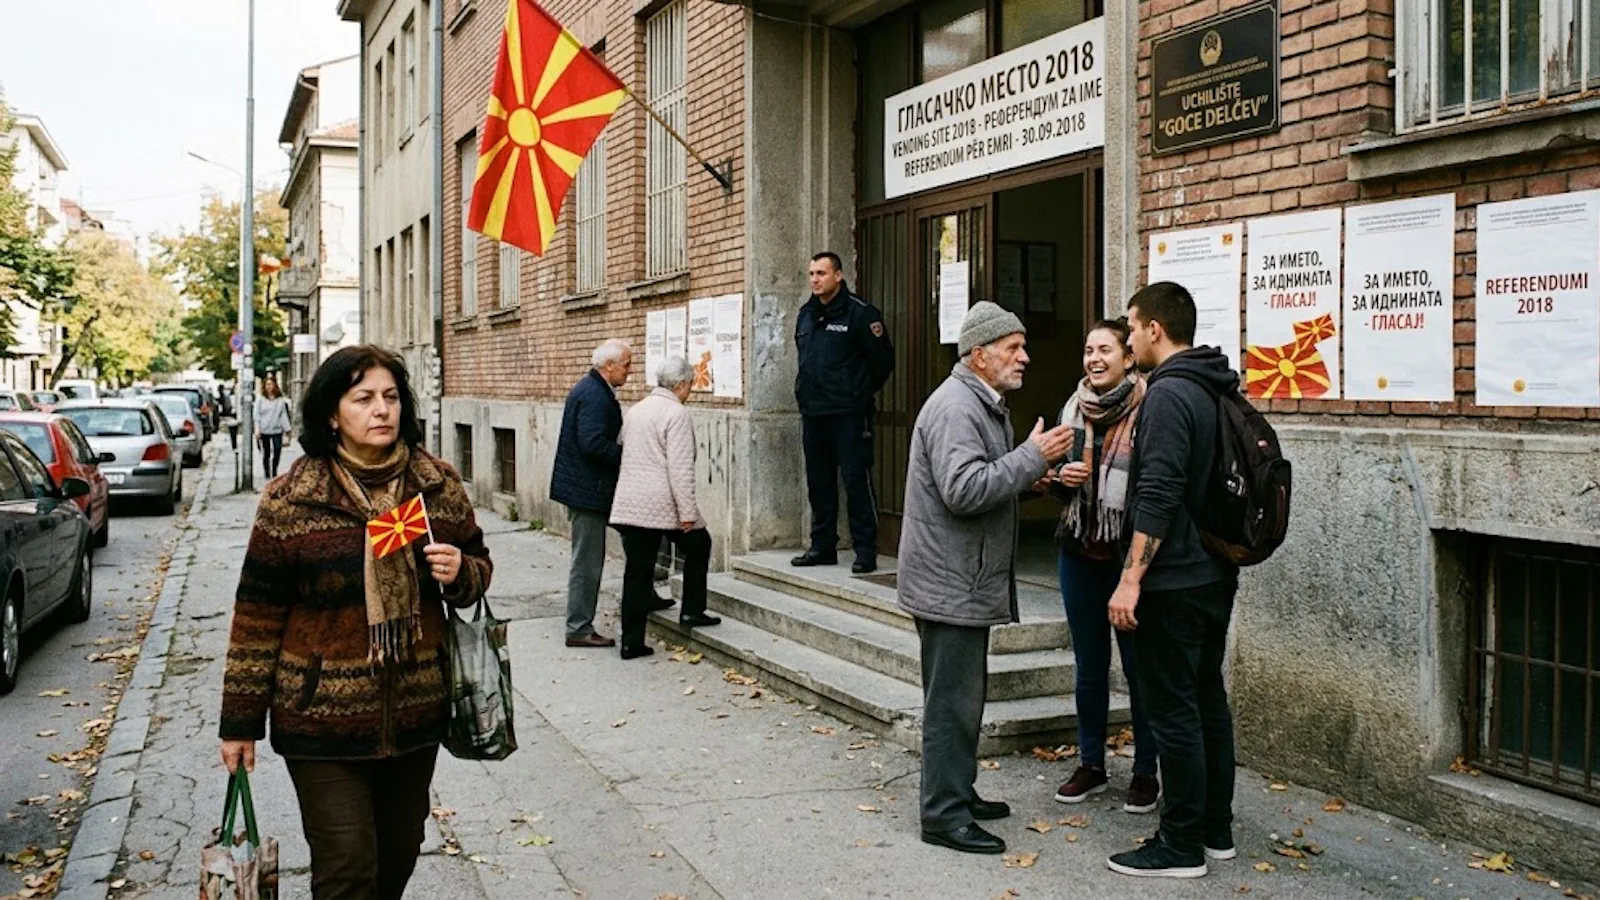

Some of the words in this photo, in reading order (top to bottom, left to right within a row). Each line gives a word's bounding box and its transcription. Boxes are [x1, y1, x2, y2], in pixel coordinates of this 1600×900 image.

[898, 82, 976, 133] ГЛАСАЧКО
[981, 59, 1040, 106] МЕСТО
[1045, 40, 1094, 84] 2018
[1181, 80, 1241, 111] UCHILIŠTE
[932, 125, 951, 147] SITE
[952, 118, 976, 141] 2018
[984, 91, 1059, 131] РЕФЕРЕНДУМ
[1062, 86, 1077, 108] ZA
[1080, 77, 1103, 102] IME
[904, 147, 964, 178] REFERENDUM
[987, 132, 1013, 156] EMRI
[1022, 112, 1086, 147] 30.09.2018
[1262, 254, 1276, 271] ЗА
[1252, 274, 1267, 291] ЗА
[1364, 273, 1380, 290] ЗА
[1383, 269, 1433, 288] ИМЕТО,
[1486, 272, 1589, 296] REFERENDUMI
[1270, 291, 1317, 309] ГЛАСАЈ!
[1352, 293, 1368, 311] ЗА
[1371, 289, 1443, 312] ИДНИНАТА
[1517, 296, 1554, 314] 2018
[1372, 312, 1425, 331] ГЛАСАЈ!
